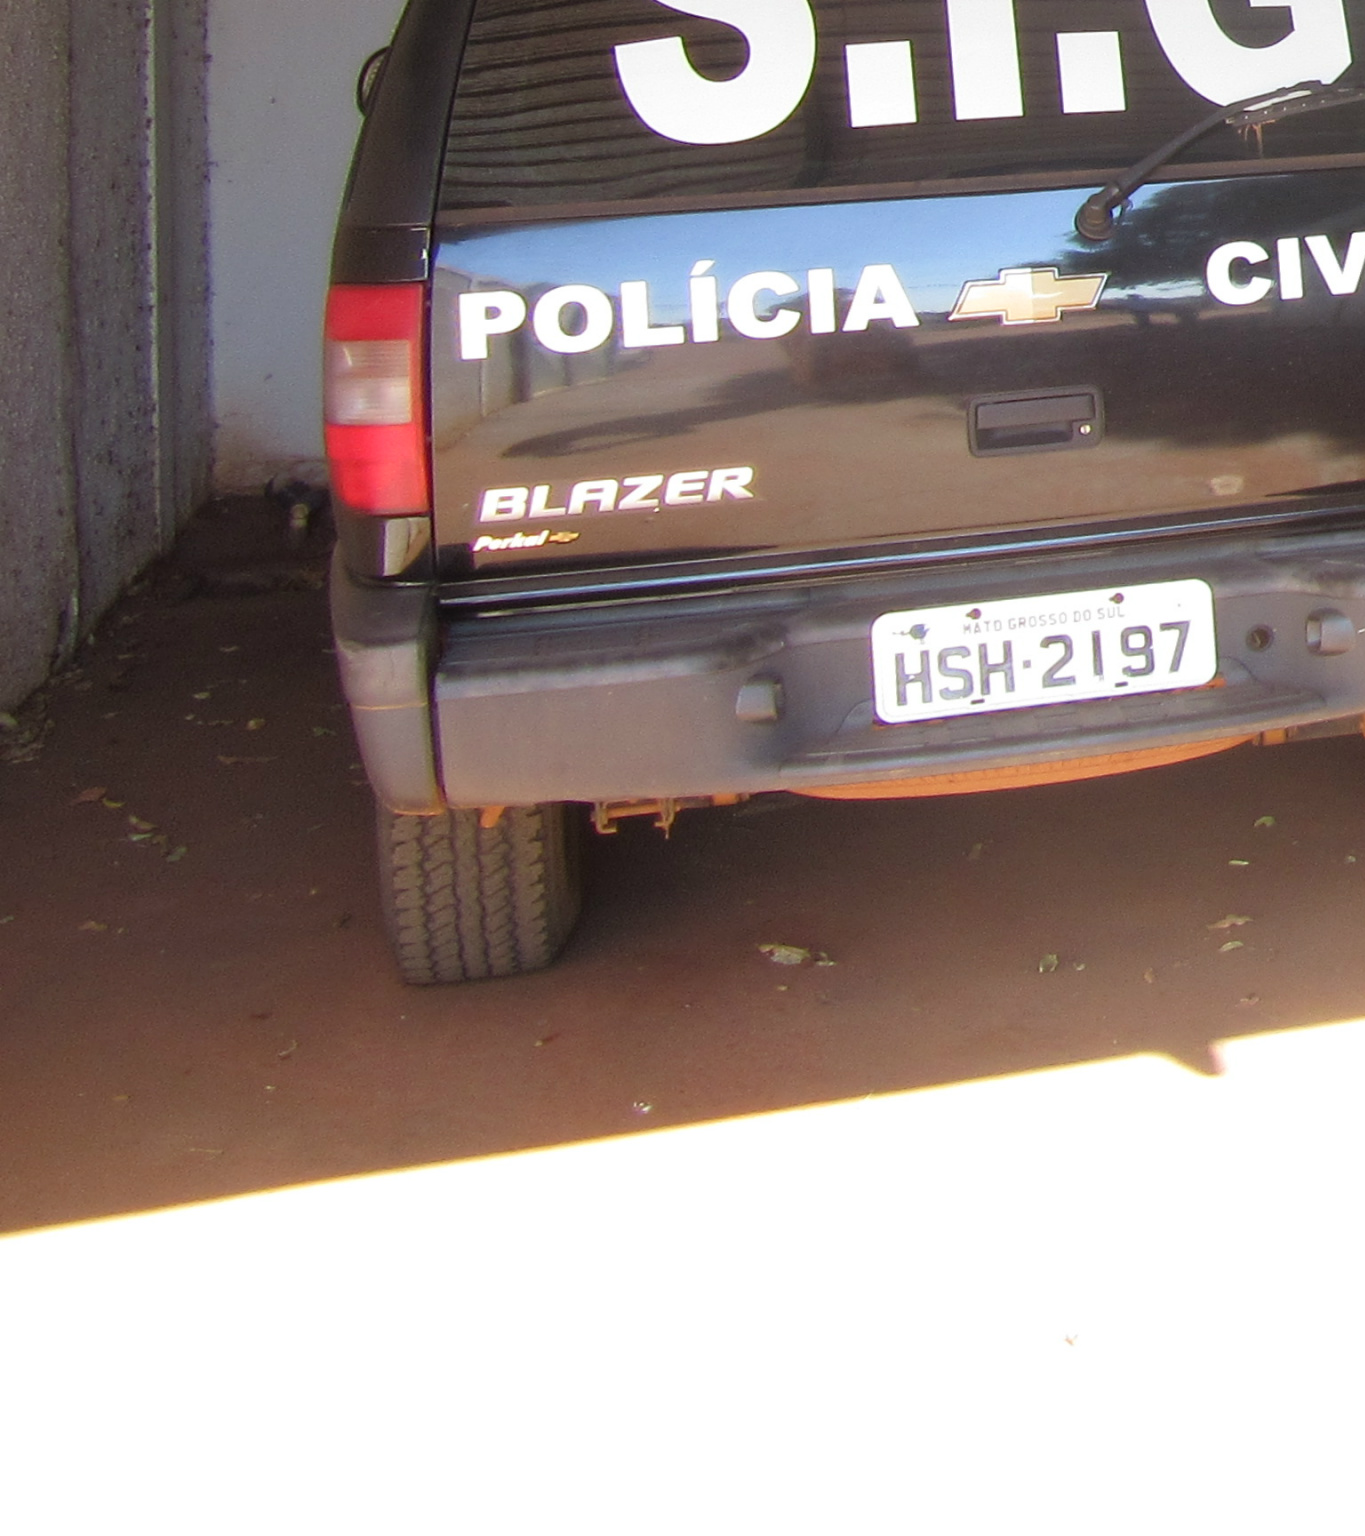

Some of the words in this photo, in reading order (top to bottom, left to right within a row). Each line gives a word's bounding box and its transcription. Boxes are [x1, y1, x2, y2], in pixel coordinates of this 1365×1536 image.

[457, 259, 920, 360] POLÍCIA
[479, 466, 754, 523] BLAZER
[963, 620, 1003, 634] MATO
[1008, 612, 1068, 630] GROSSO
[1073, 609, 1092, 623] DO
[1097, 606, 1126, 619] SUL
